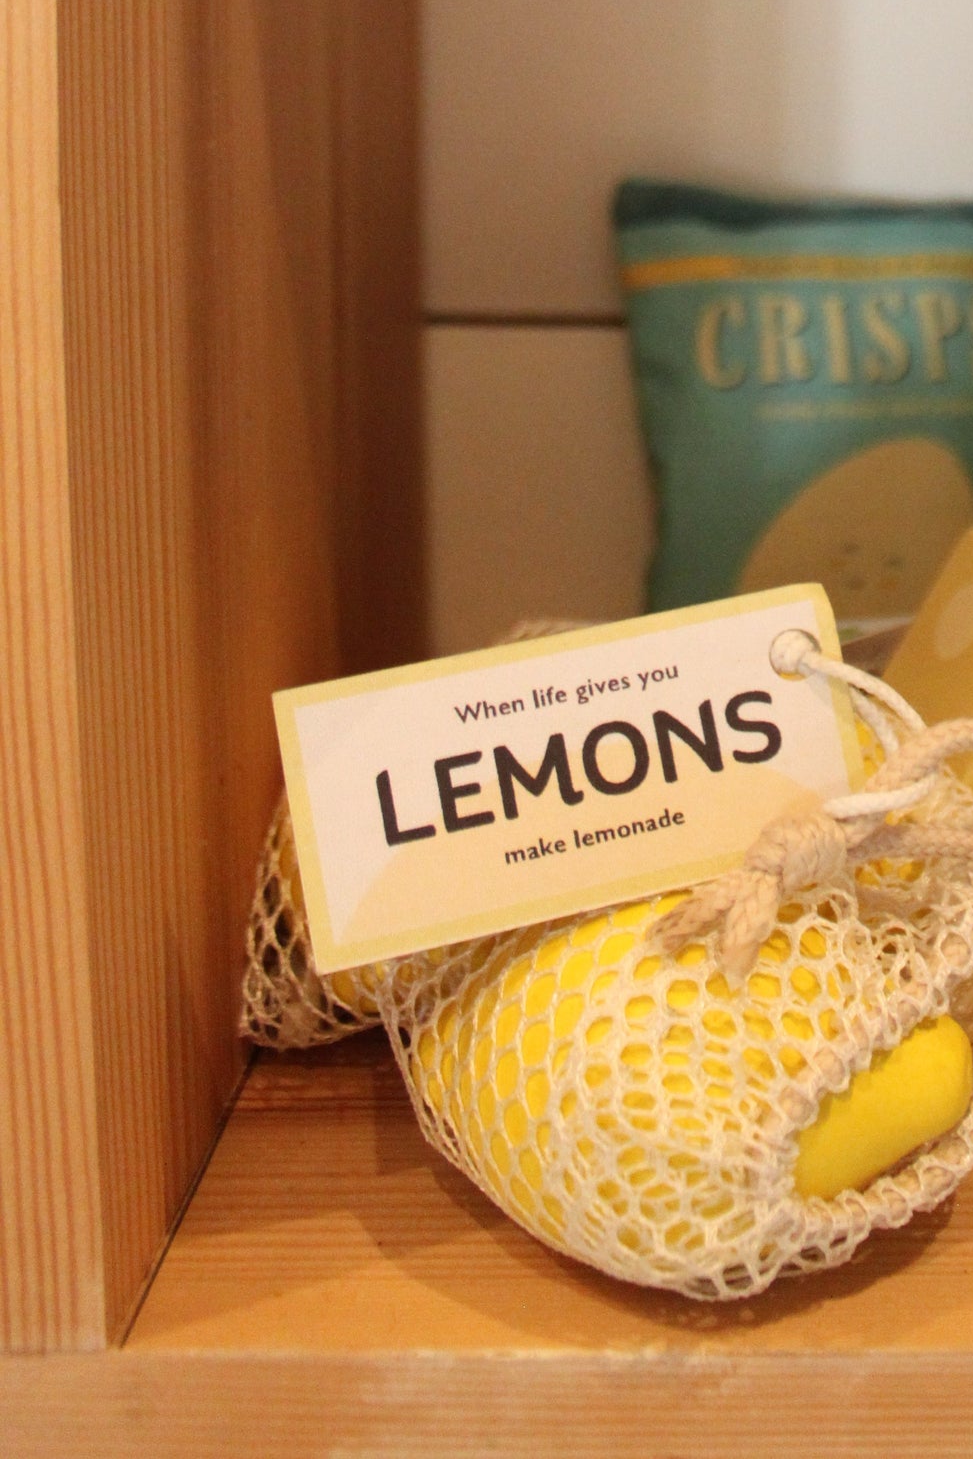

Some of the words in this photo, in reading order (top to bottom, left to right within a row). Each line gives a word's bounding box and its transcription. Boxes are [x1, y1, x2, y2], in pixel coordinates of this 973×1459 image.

[454, 698, 525, 724] When
[532, 685, 568, 709] life
[576, 674, 631, 705] gives
[638, 664, 680, 691] you
[375, 690, 784, 847] LEMONS
[504, 837, 567, 865] make
[573, 808, 686, 849] lemonade
